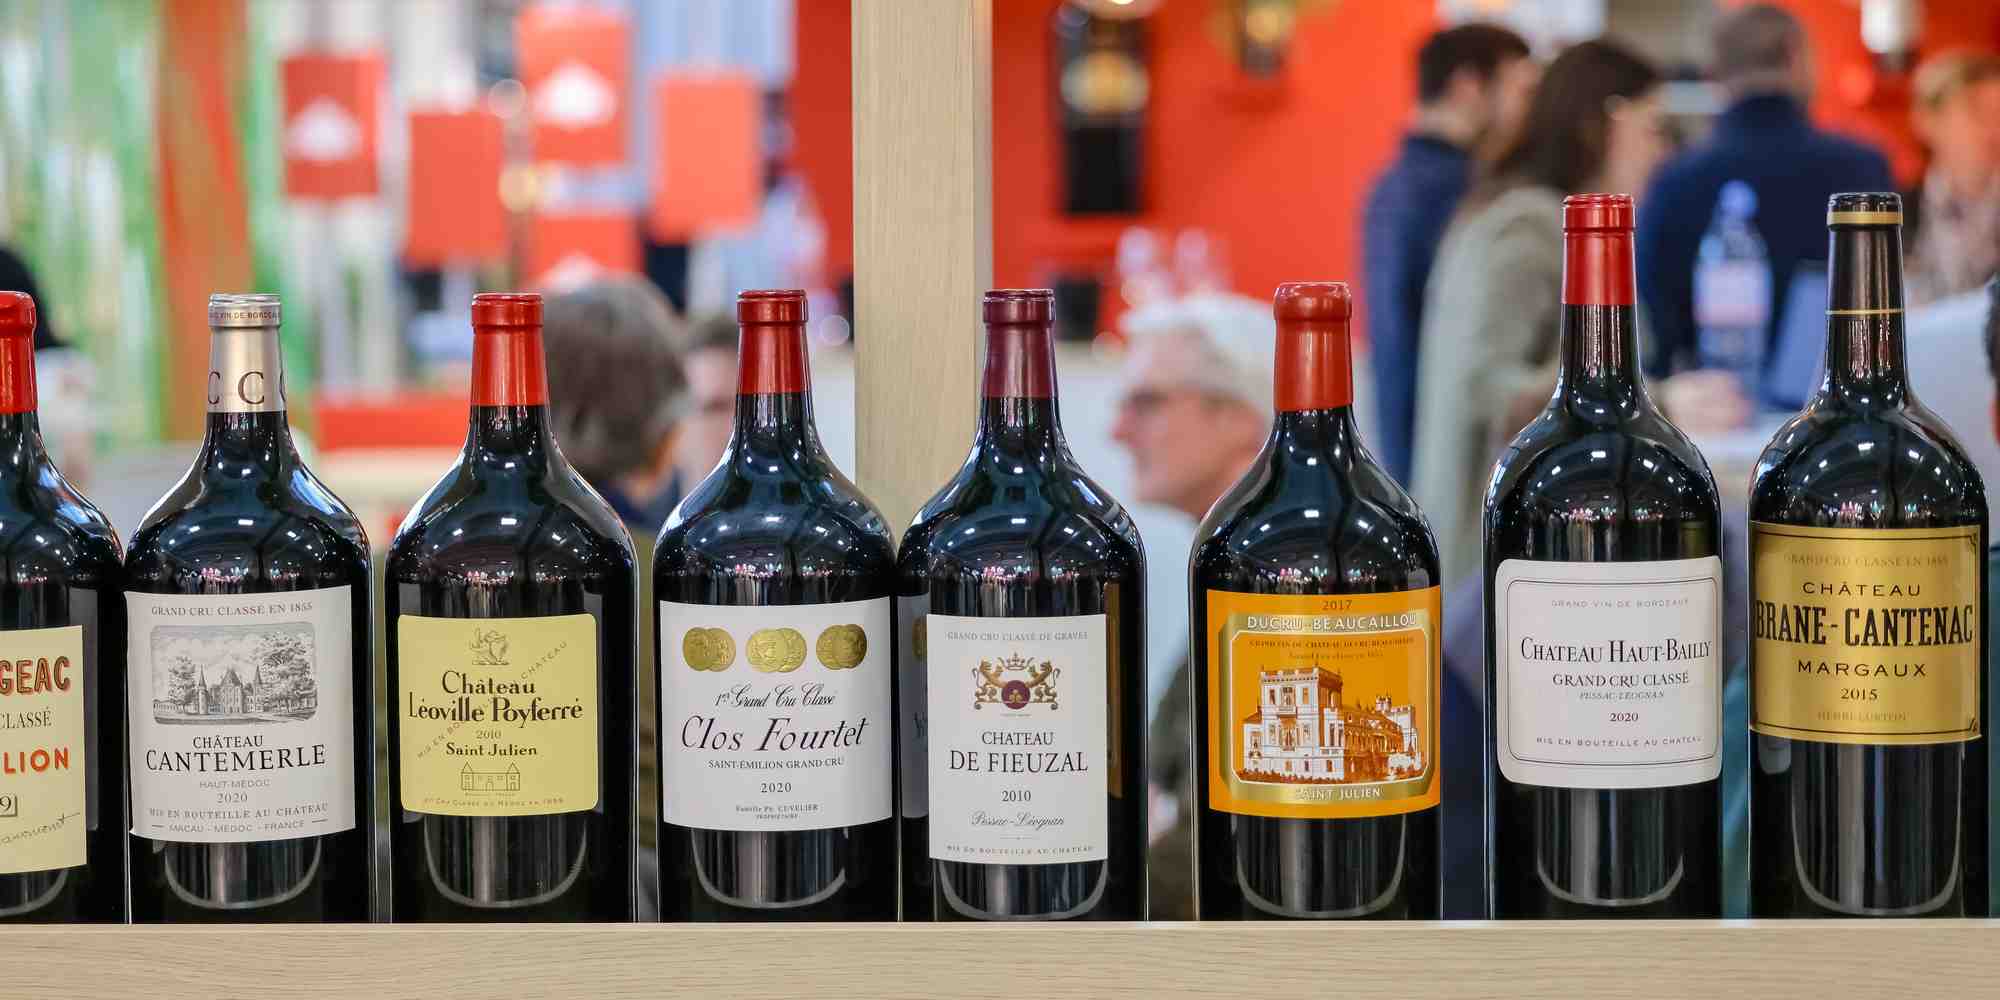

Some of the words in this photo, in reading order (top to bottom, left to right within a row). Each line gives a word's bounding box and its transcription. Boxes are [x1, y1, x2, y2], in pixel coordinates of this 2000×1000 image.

[238, 371, 264, 404] C
[1802, 580, 1921, 597] CHÂTEAU
[151, 606, 186, 616] GRAND
[189, 607, 213, 616] CRU
[269, 604, 286, 614] EN
[290, 602, 312, 613] 1855
[1322, 599, 1353, 611] 2017
[1551, 600, 1588, 608] GRAND
[1593, 600, 1613, 609] VIN
[1617, 600, 1630, 608] DE
[946, 631, 977, 640] GRAND
[1608, 638, 1713, 664] HAUT-BAILLY
[1798, 660, 1927, 677] MARGAUX
[442, 670, 537, 695] Château
[1552, 673, 1606, 688] GRAND
[1610, 674, 1640, 688] CRU
[731, 682, 771, 708] Grand
[1840, 687, 1879, 701] 2015
[409, 691, 485, 722] Léoville
[1609, 712, 1639, 722] 2020
[682, 715, 745, 751] Clos
[752, 716, 870, 752] Fourtet
[193, 734, 264, 749] CHÂTEAU
[1536, 737, 1553, 745] MIS
[1578, 739, 1640, 747] BOUTEILLE
[446, 742, 484, 756] Saint
[488, 743, 537, 756] Julien
[3, 747, 69, 774] LION
[146, 744, 326, 773] CANTEMERLE
[786, 759, 822, 769] GRAND
[825, 756, 845, 767] CRU
[950, 750, 980, 772] DE
[987, 751, 1089, 773] FIEUZAL
[761, 782, 792, 794] 2020
[216, 792, 248, 803] 2020
[1001, 790, 1032, 802] 2010
[168, 809, 180, 818] EN
[184, 810, 250, 820] BOUTEILLE
[255, 809, 271, 818] AU
[169, 824, 204, 833] MACAU
